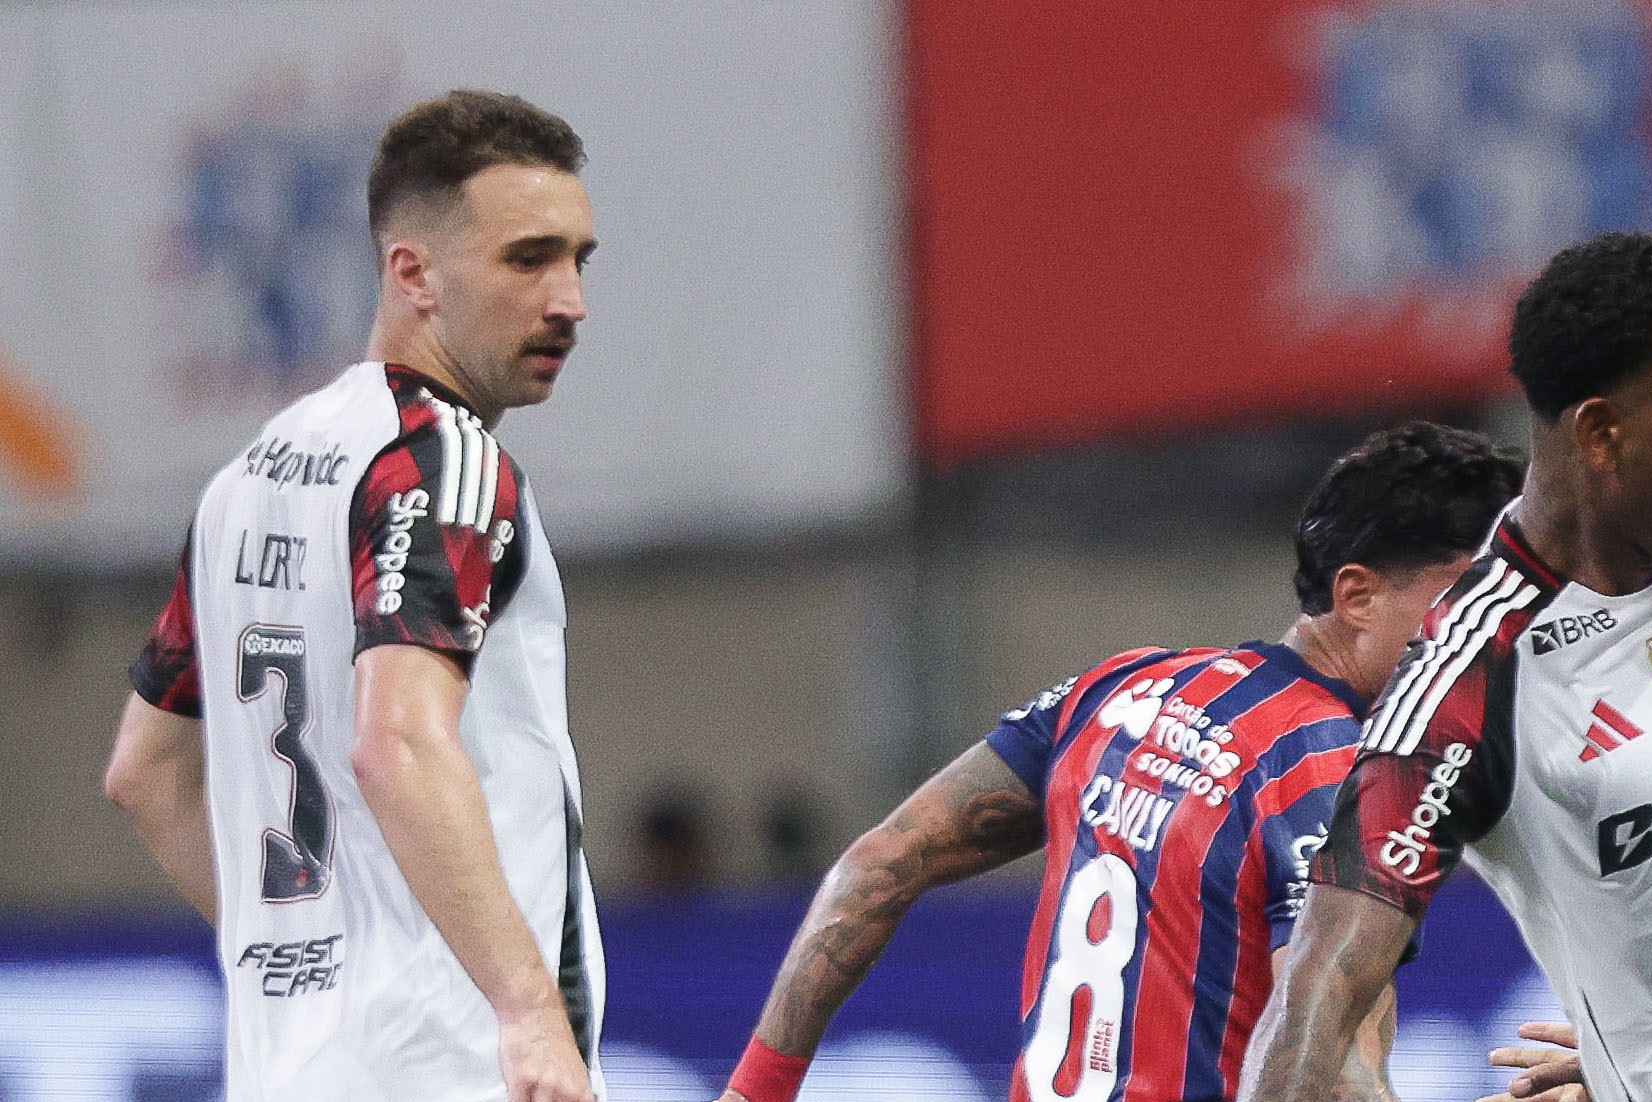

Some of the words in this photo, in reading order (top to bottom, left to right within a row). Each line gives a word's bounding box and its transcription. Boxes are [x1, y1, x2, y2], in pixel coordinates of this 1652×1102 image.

[376, 488, 430, 617] Shopee
[1559, 607, 1618, 645] BRB
[1155, 715, 1242, 778] TODOS
[1167, 696, 1212, 730] Cartão
[1208, 724, 1235, 744] de
[236, 622, 337, 904] 3
[1137, 752, 1229, 808] SONHOS
[1380, 742, 1472, 876] Shopee
